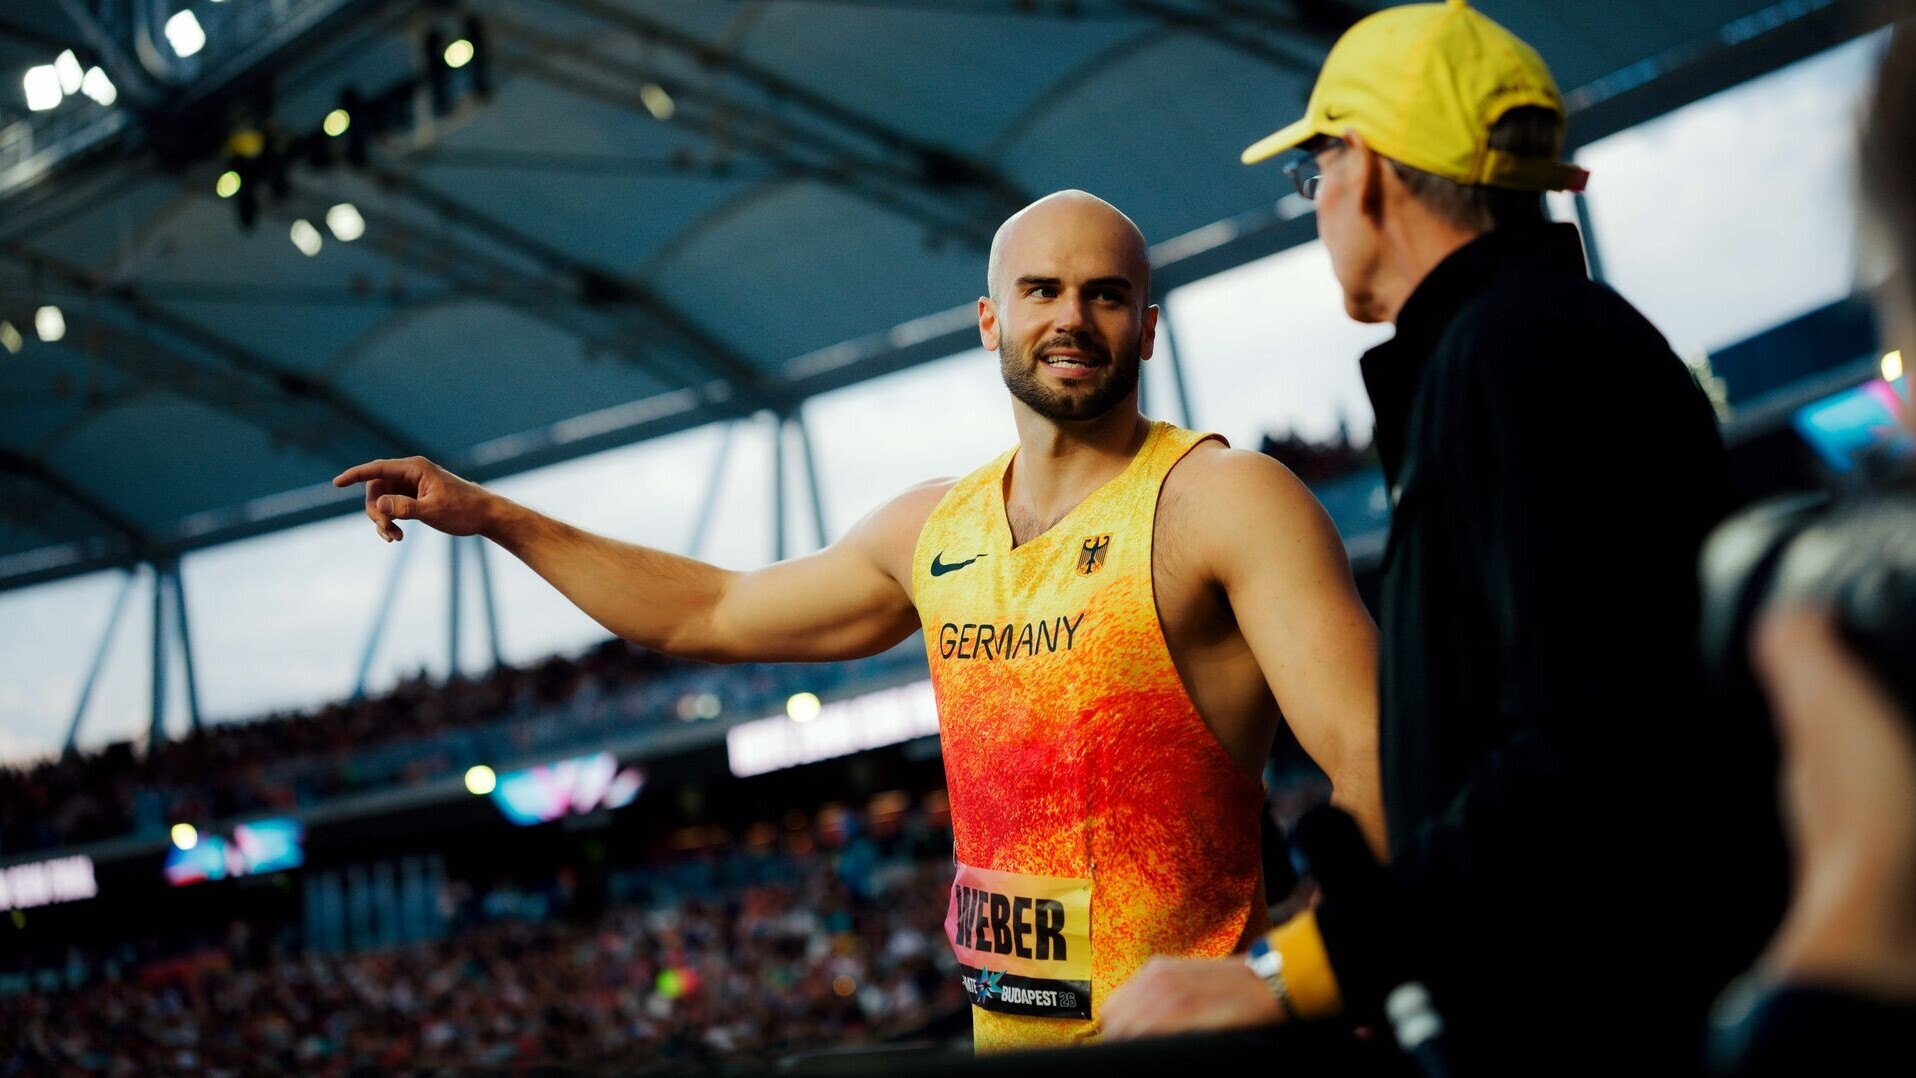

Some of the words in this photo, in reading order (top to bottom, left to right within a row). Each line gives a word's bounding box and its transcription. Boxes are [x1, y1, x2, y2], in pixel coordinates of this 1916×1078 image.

[940, 613, 1084, 660] GERMANY
[956, 885, 1067, 961] WEBER
[1001, 985, 1057, 1007] BUDAPEST
[1059, 992, 1076, 1008] 26
